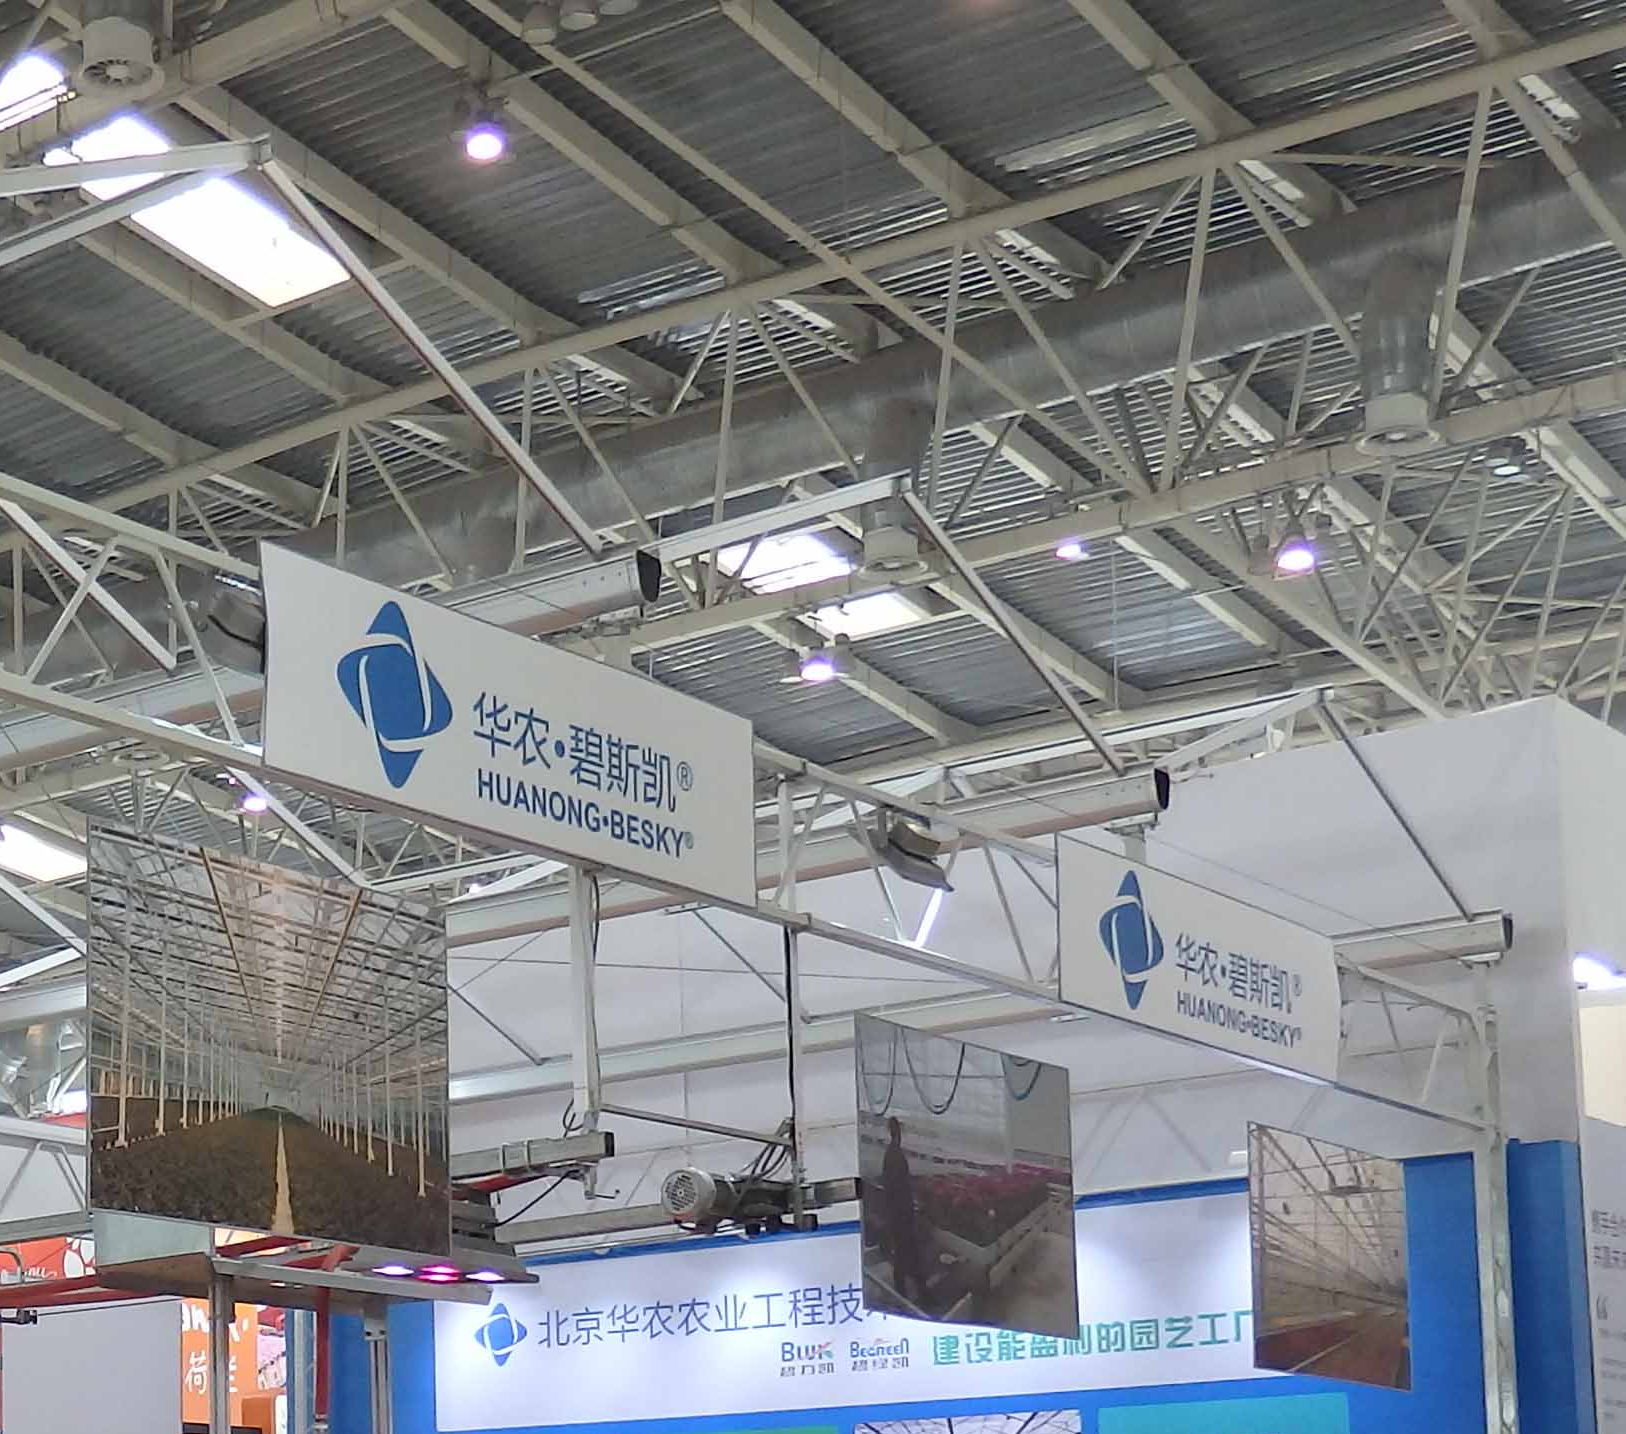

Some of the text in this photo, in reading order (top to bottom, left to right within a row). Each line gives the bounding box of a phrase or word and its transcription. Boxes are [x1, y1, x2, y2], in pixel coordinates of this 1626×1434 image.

[537, 1283, 887, 1349] 北京华农农业工程技
